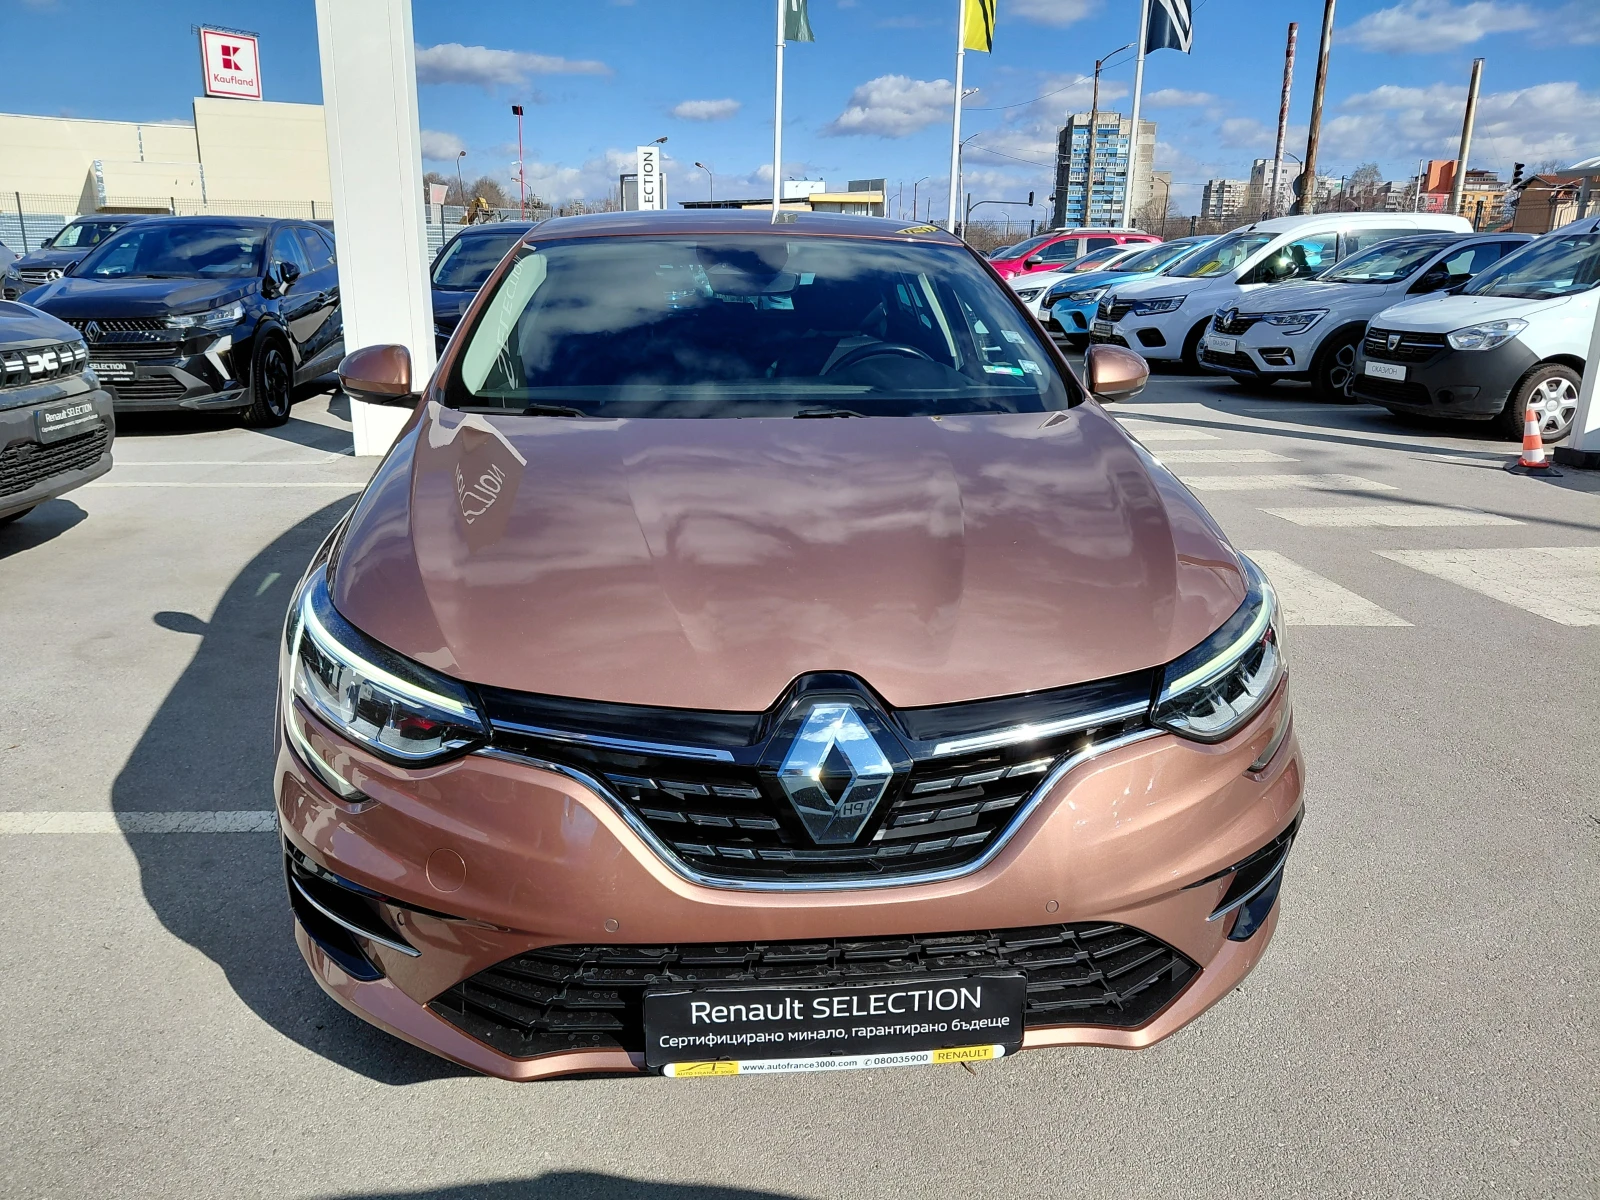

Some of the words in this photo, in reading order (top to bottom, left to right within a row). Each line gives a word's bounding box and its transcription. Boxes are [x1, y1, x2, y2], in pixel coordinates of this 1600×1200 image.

[213, 73, 254, 87] Kaufland
[45, 410, 67, 422] Renault
[67, 403, 93, 418] SELECTION
[690, 998, 804, 1025] Renault
[812, 986, 981, 1019] SELECTION
[659, 1030, 784, 1049] Сертифицирано
[788, 1027, 848, 1041] минало,
[852, 1021, 948, 1039] гарантирано
[951, 1016, 1010, 1031] бъдеще
[742, 1059, 857, 1071] www.autofrance3000.com
[873, 1054, 929, 1065] 080035900
[938, 1049, 990, 1061] RENAULT
